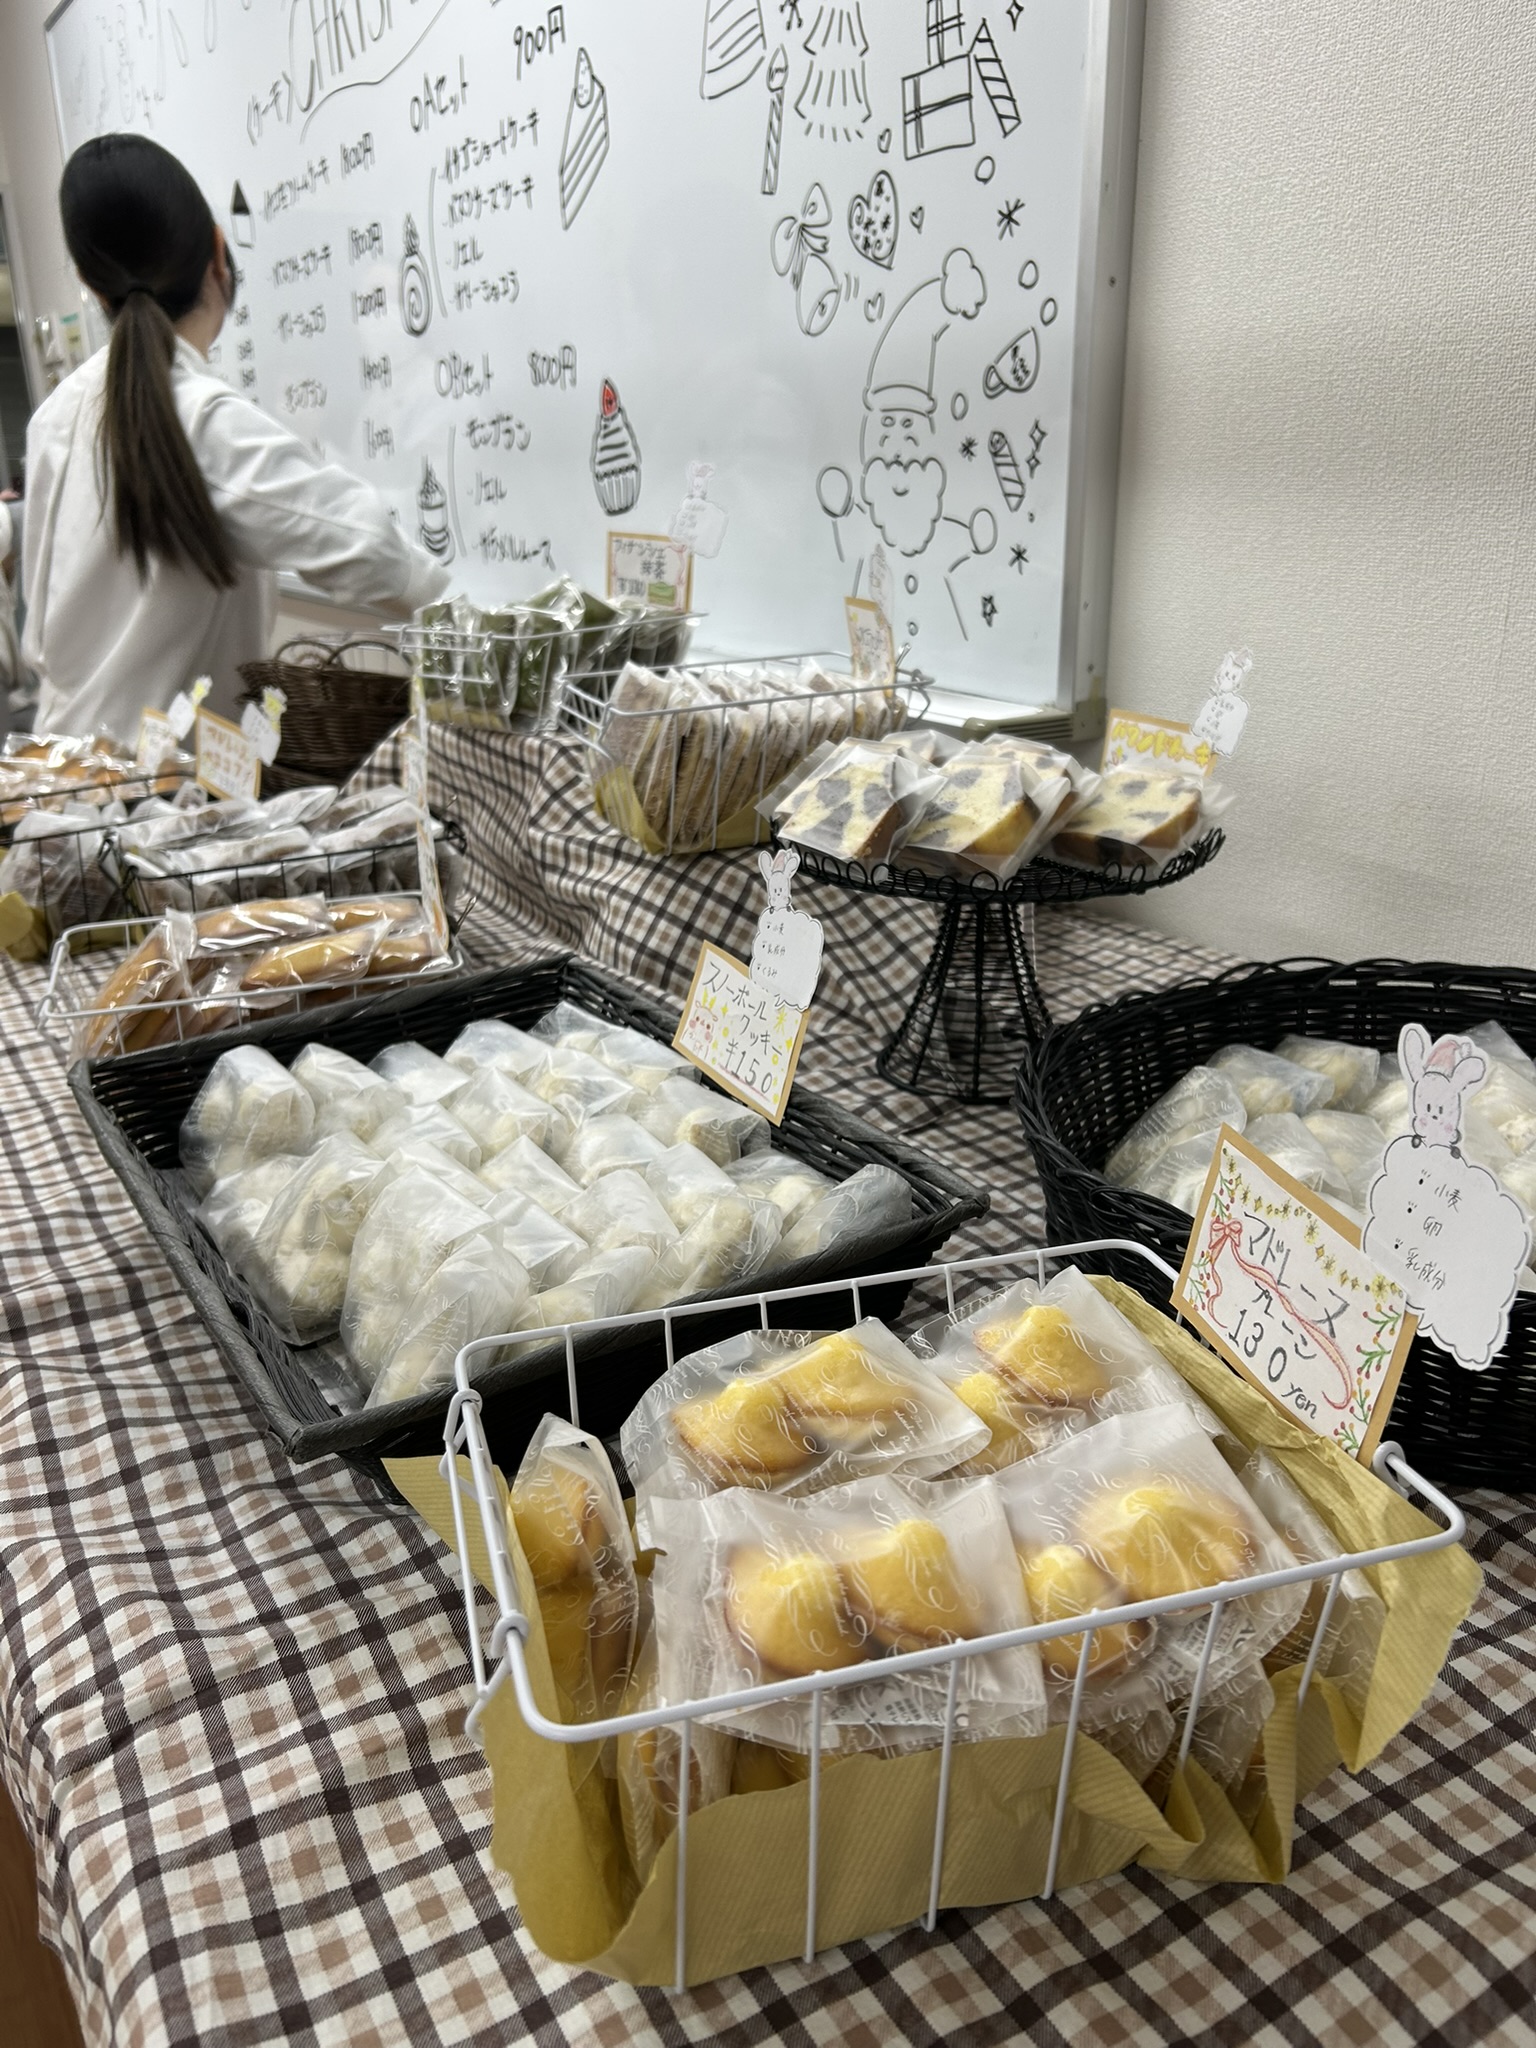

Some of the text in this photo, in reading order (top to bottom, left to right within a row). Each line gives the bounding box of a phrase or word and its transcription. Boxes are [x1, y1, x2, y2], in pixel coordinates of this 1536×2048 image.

[513, 5, 565, 81] 900円
[528, 345, 577, 390] 800円
[702, 961, 767, 1021] スノーボール
[740, 1014, 783, 1056] クッキー
[725, 1037, 773, 1094] ¥150
[1434, 1183, 1463, 1213] 小麦
[1422, 1216, 1443, 1237] 卵
[1244, 1211, 1350, 1339] マドレーヌ
[1405, 1246, 1447, 1291] 乳成分
[1228, 1308, 1318, 1420] 130 yen
